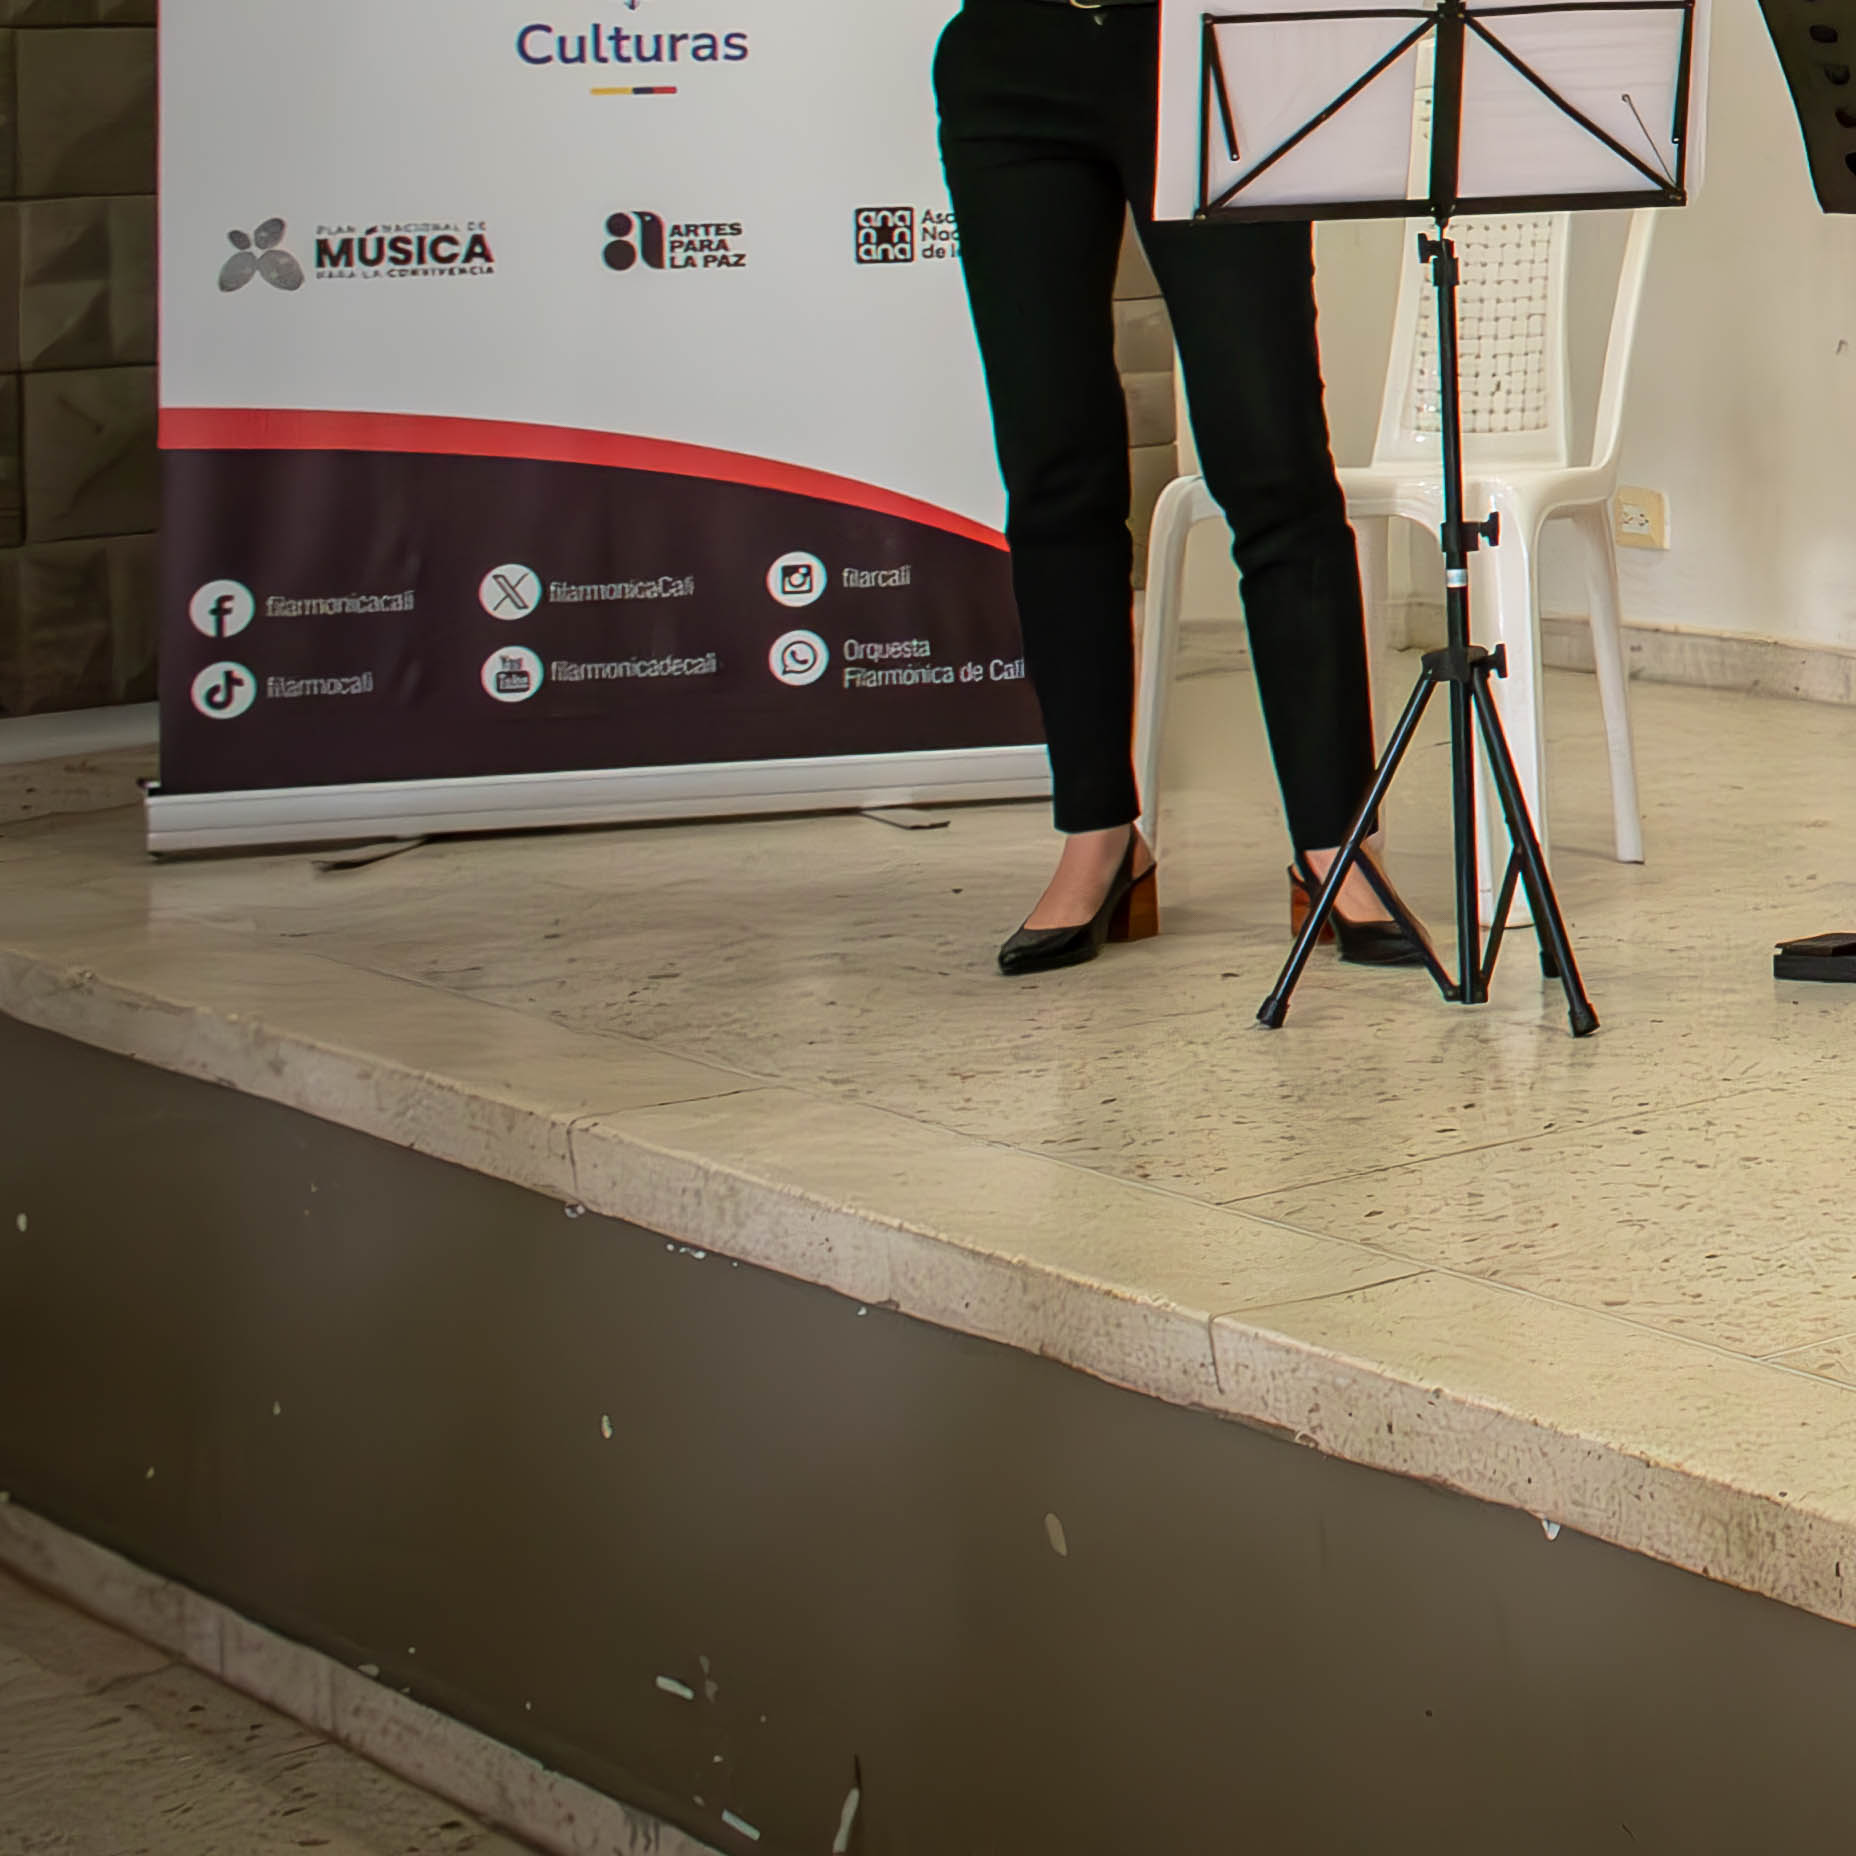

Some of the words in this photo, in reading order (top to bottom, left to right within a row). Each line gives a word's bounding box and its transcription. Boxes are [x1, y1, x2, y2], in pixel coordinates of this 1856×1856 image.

[516, 22, 749, 65] Culturas
[669, 222, 744, 238] ARTES
[315, 225, 495, 269] MÚSICA
[669, 238, 730, 253] PARA
[921, 243, 946, 259] de
[669, 254, 698, 269] LA
[702, 253, 747, 268] PAZ
[843, 639, 931, 662] Orquesta
[843, 662, 955, 689] Filarmónica
[959, 661, 983, 682] de
[988, 657, 1026, 681] Cali
